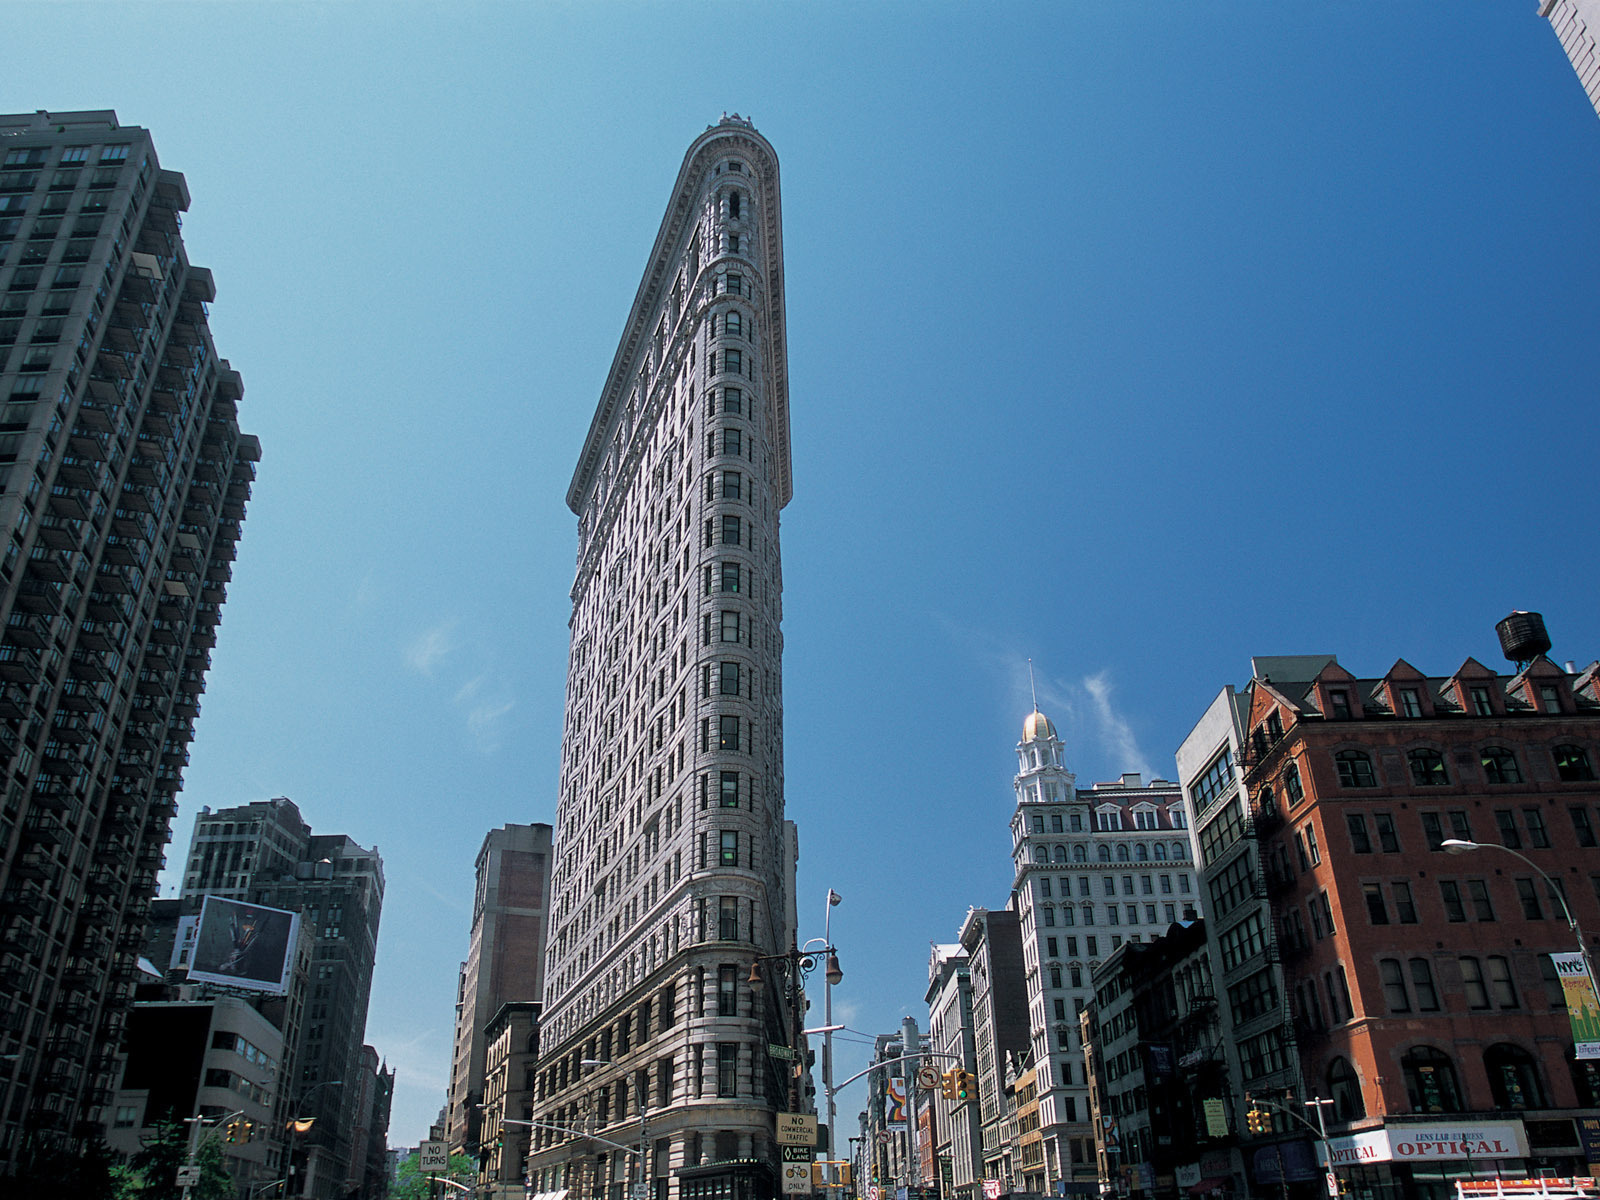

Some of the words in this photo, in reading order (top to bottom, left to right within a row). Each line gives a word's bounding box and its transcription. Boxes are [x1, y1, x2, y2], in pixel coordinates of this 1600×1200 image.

[1556, 960, 1584, 973] NYC
[791, 1117, 804, 1126] NO
[780, 1126, 814, 1135] COMMERCIAL
[786, 1133, 809, 1142] TRAFFIC
[1416, 1133, 1434, 1141] LENS
[1435, 1133, 1449, 1141] LAB
[428, 1146, 441, 1155] NO
[1396, 1140, 1509, 1156] OPTICAL
[1331, 1145, 1378, 1162] OPTICAL
[422, 1156, 446, 1166] TURNS
